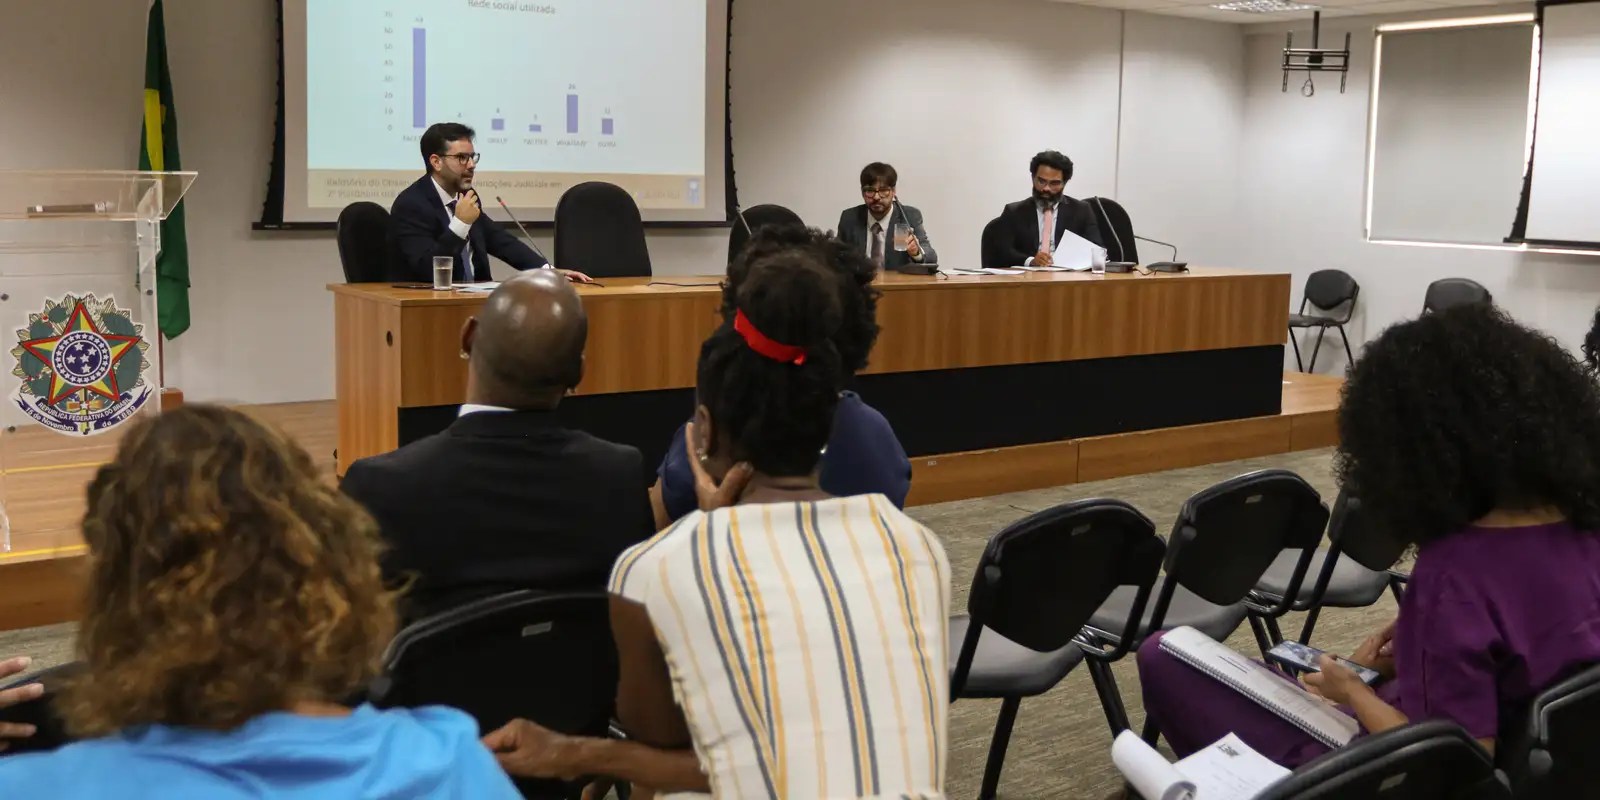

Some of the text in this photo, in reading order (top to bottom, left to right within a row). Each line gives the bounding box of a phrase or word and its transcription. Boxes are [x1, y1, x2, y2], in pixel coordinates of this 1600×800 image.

[468, 0, 556, 15] Rede social utilizada
[26, 405, 136, 431] 15 de Novembro de 1889
[69, 412, 105, 421] FEDERATIVA
[113, 398, 130, 410] BRASIL
